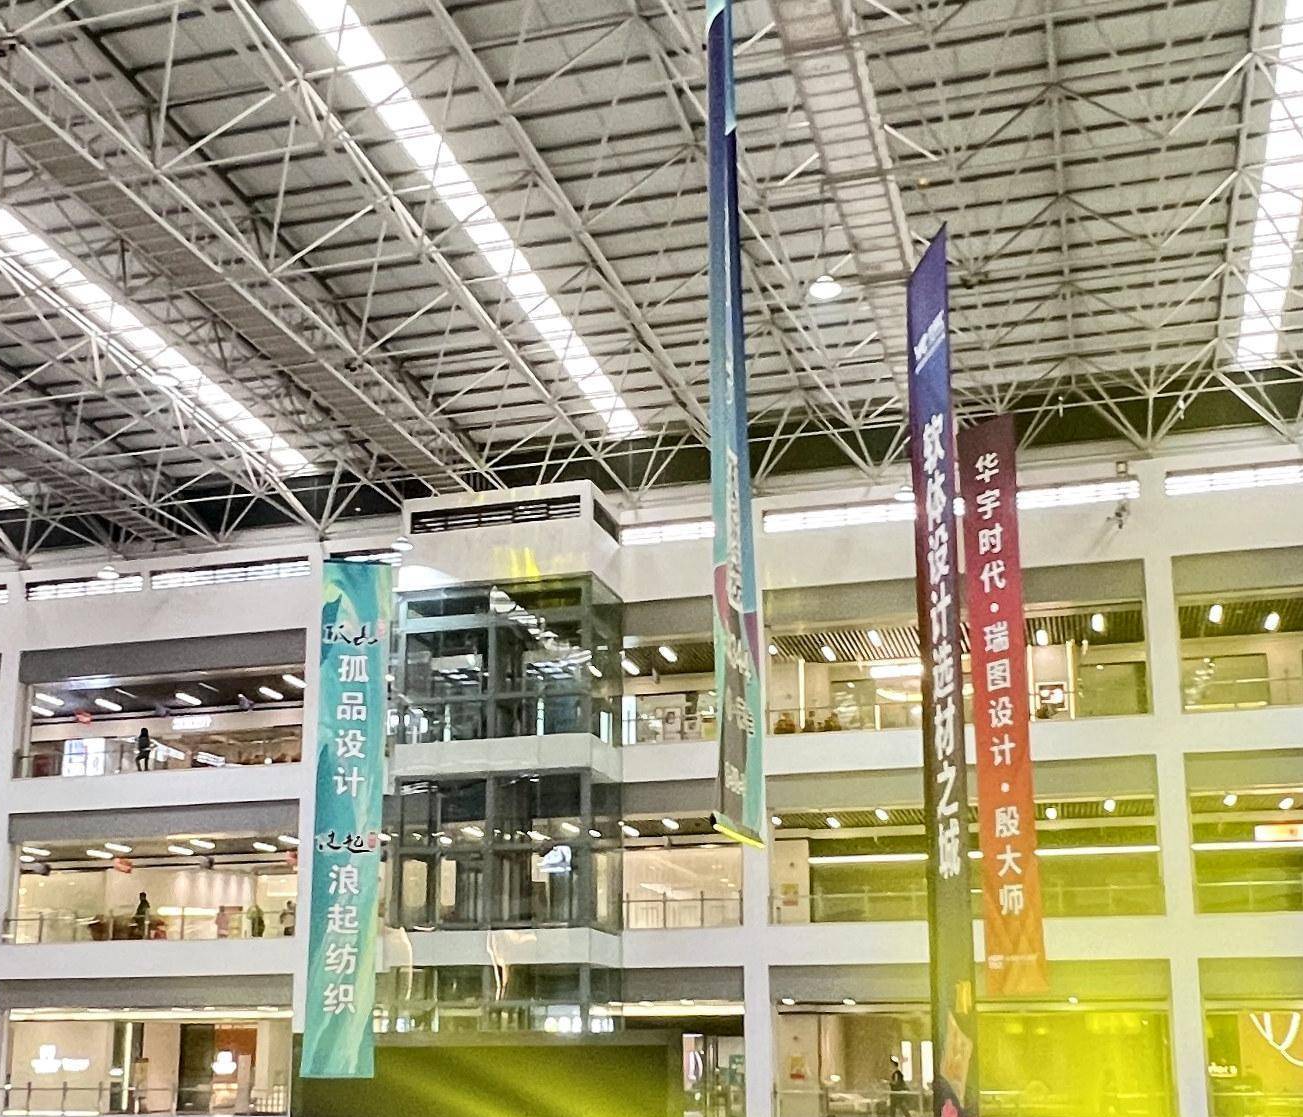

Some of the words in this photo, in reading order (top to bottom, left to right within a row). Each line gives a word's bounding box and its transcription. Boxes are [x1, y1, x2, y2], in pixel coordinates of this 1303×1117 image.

[333, 654, 369, 798] 孤品设计
[321, 864, 361, 1017] 浪起纺织
